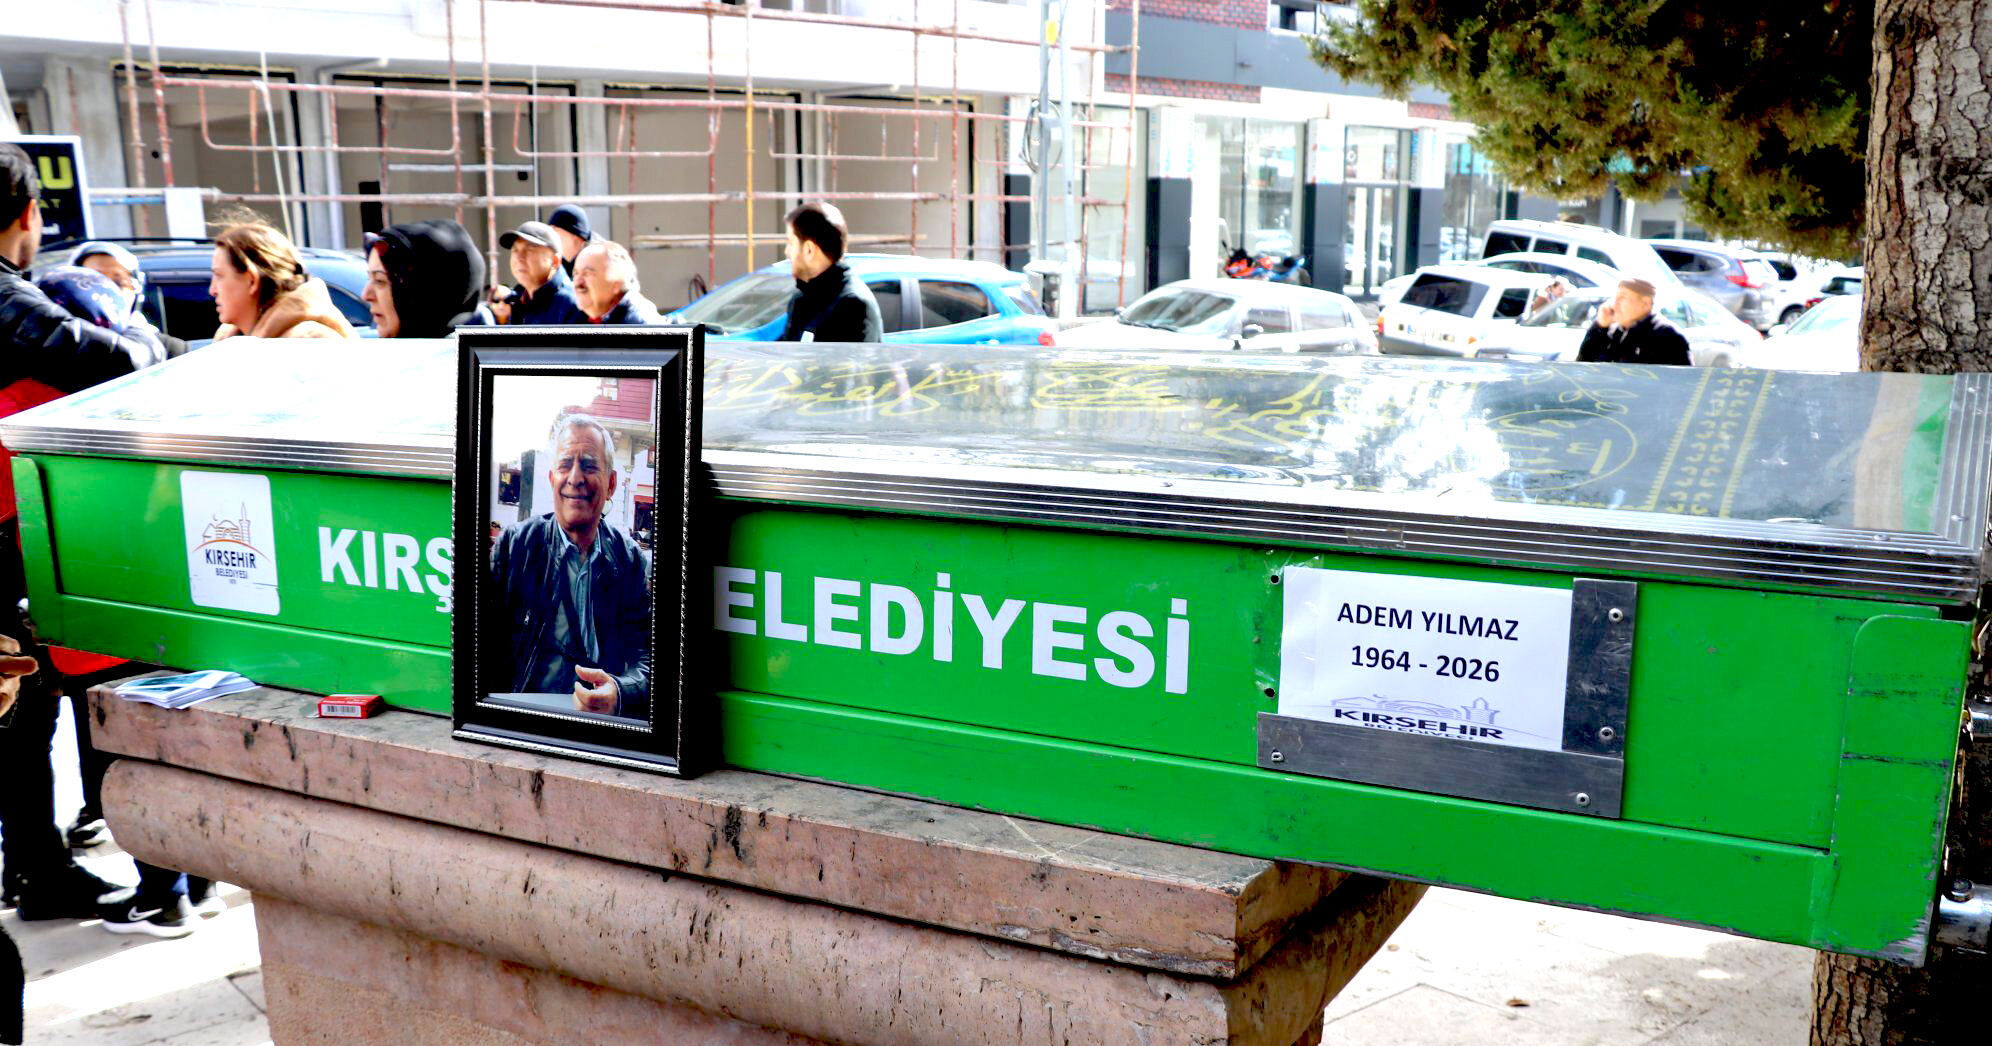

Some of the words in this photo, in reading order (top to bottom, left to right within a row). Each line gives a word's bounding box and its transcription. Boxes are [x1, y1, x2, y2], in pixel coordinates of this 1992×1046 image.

[318, 526, 452, 613] KIRŞ
[713, 566, 1191, 695] ELEDİYESİ
[1337, 602, 1413, 630] ADEM
[1421, 611, 1519, 641] YILMAZ
[1351, 645, 1411, 672] 1964
[1436, 655, 1500, 682] 2026
